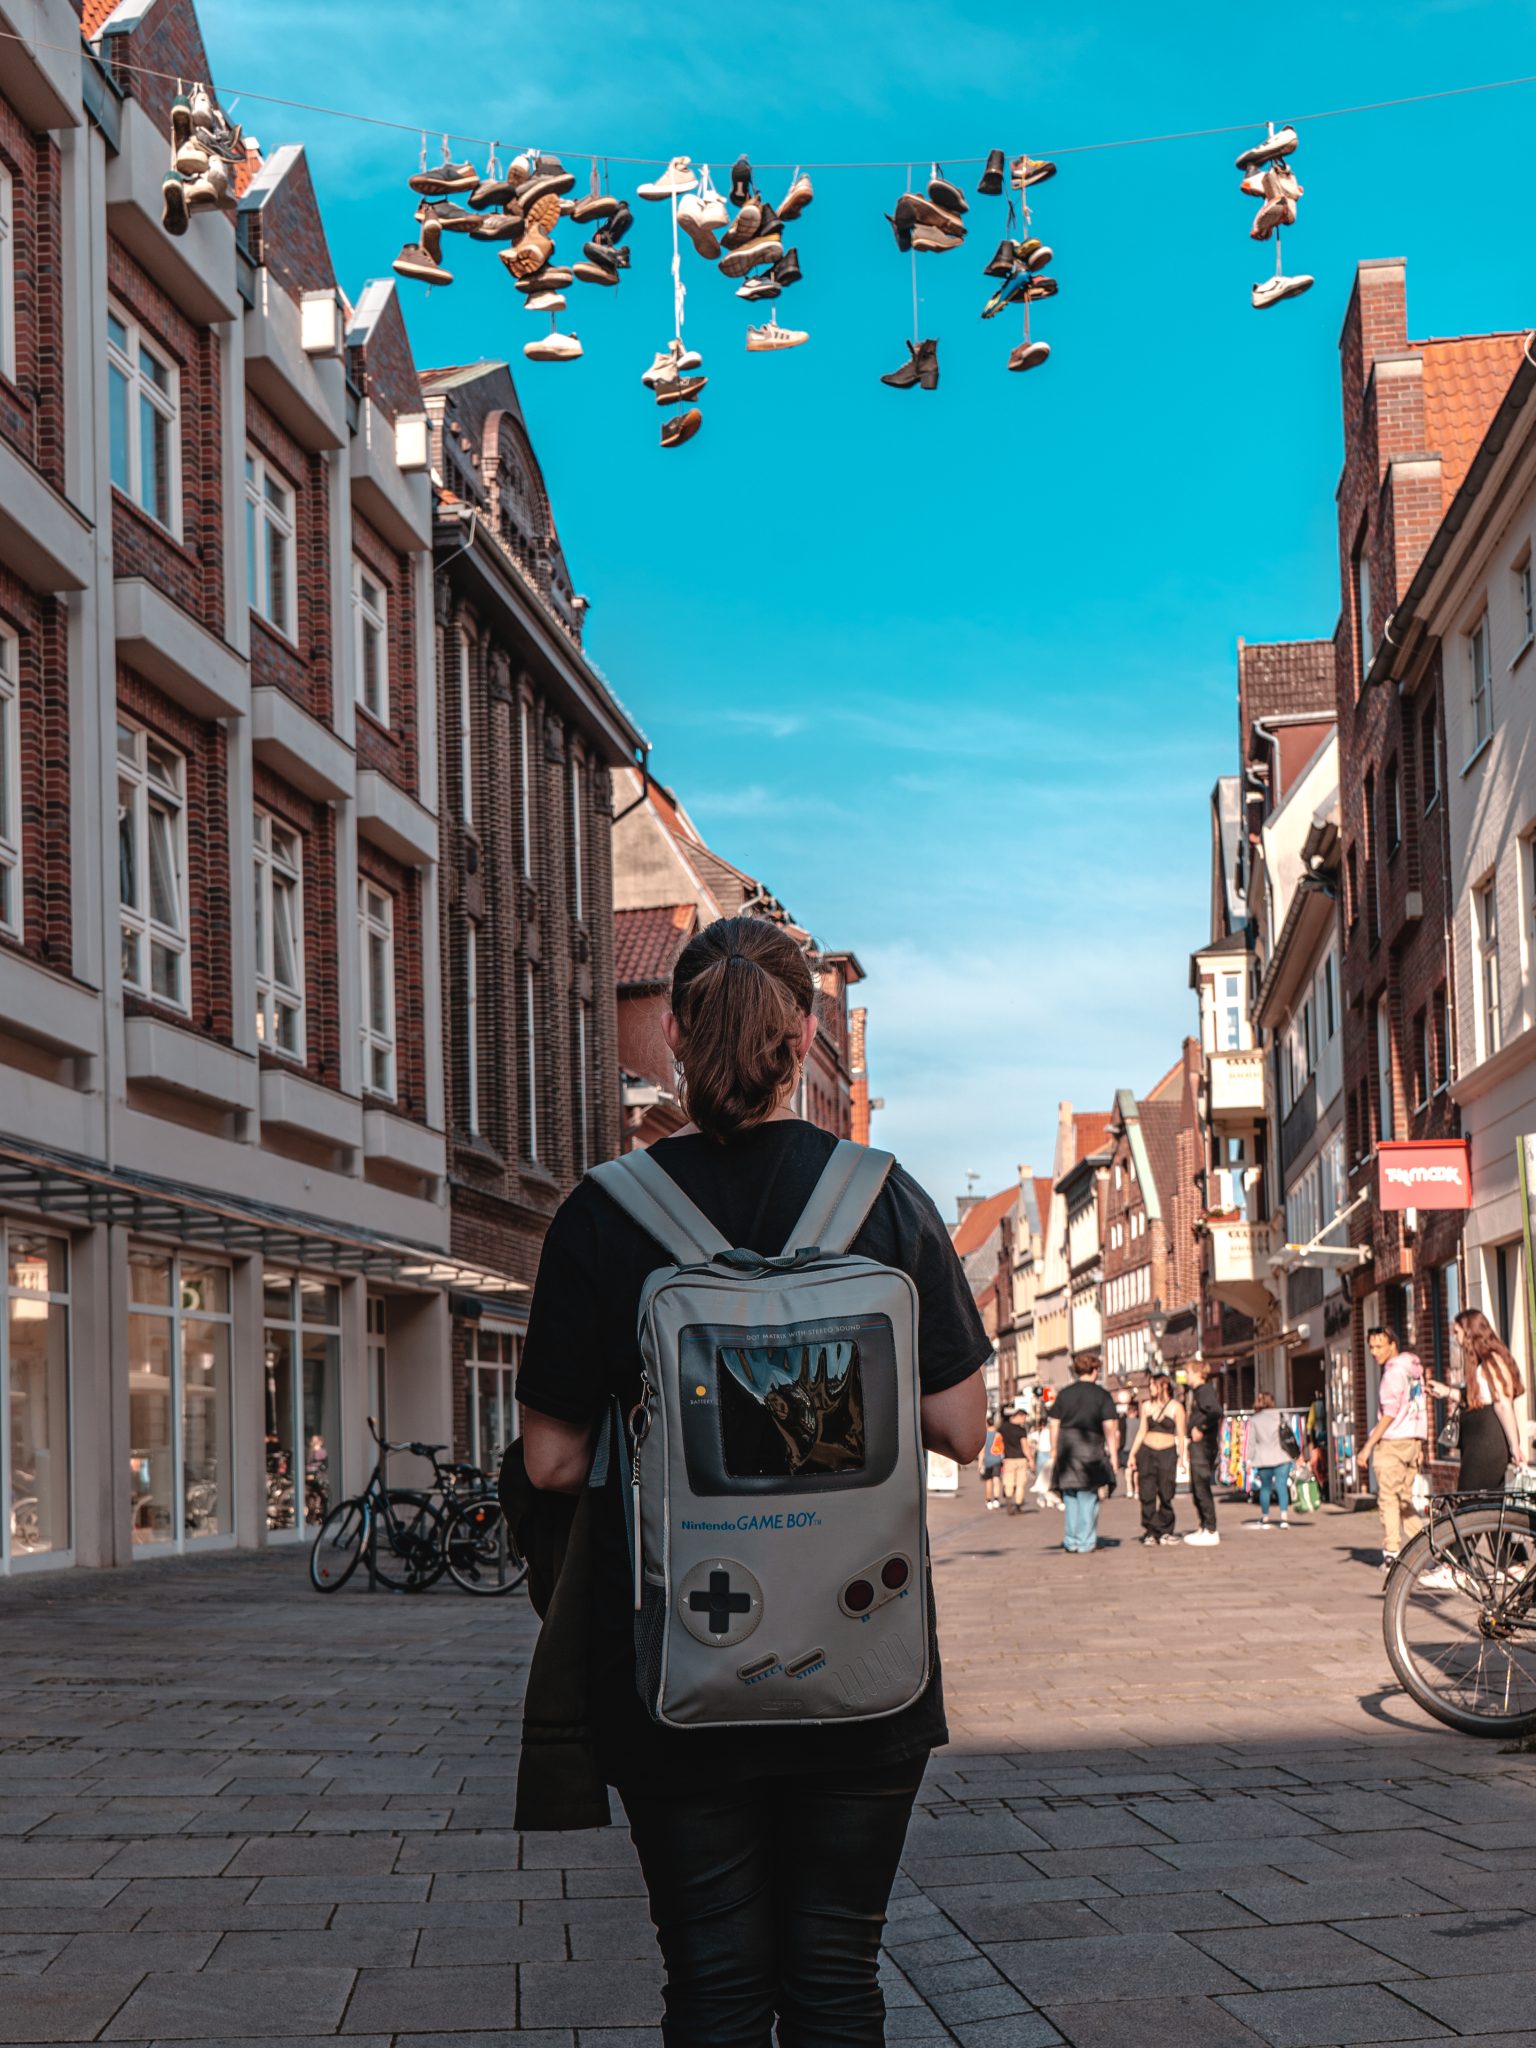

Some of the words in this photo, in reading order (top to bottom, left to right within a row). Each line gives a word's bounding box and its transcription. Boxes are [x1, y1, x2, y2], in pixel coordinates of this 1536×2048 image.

[808, 1328, 834, 1336] STEREO
[835, 1324, 861, 1333] SOUND
[681, 1520, 736, 1531] Nintendo
[737, 1514, 783, 1531] GAME
[787, 1511, 816, 1529] BOY
[744, 1663, 784, 1686] SELECT
[795, 1659, 827, 1680] START
